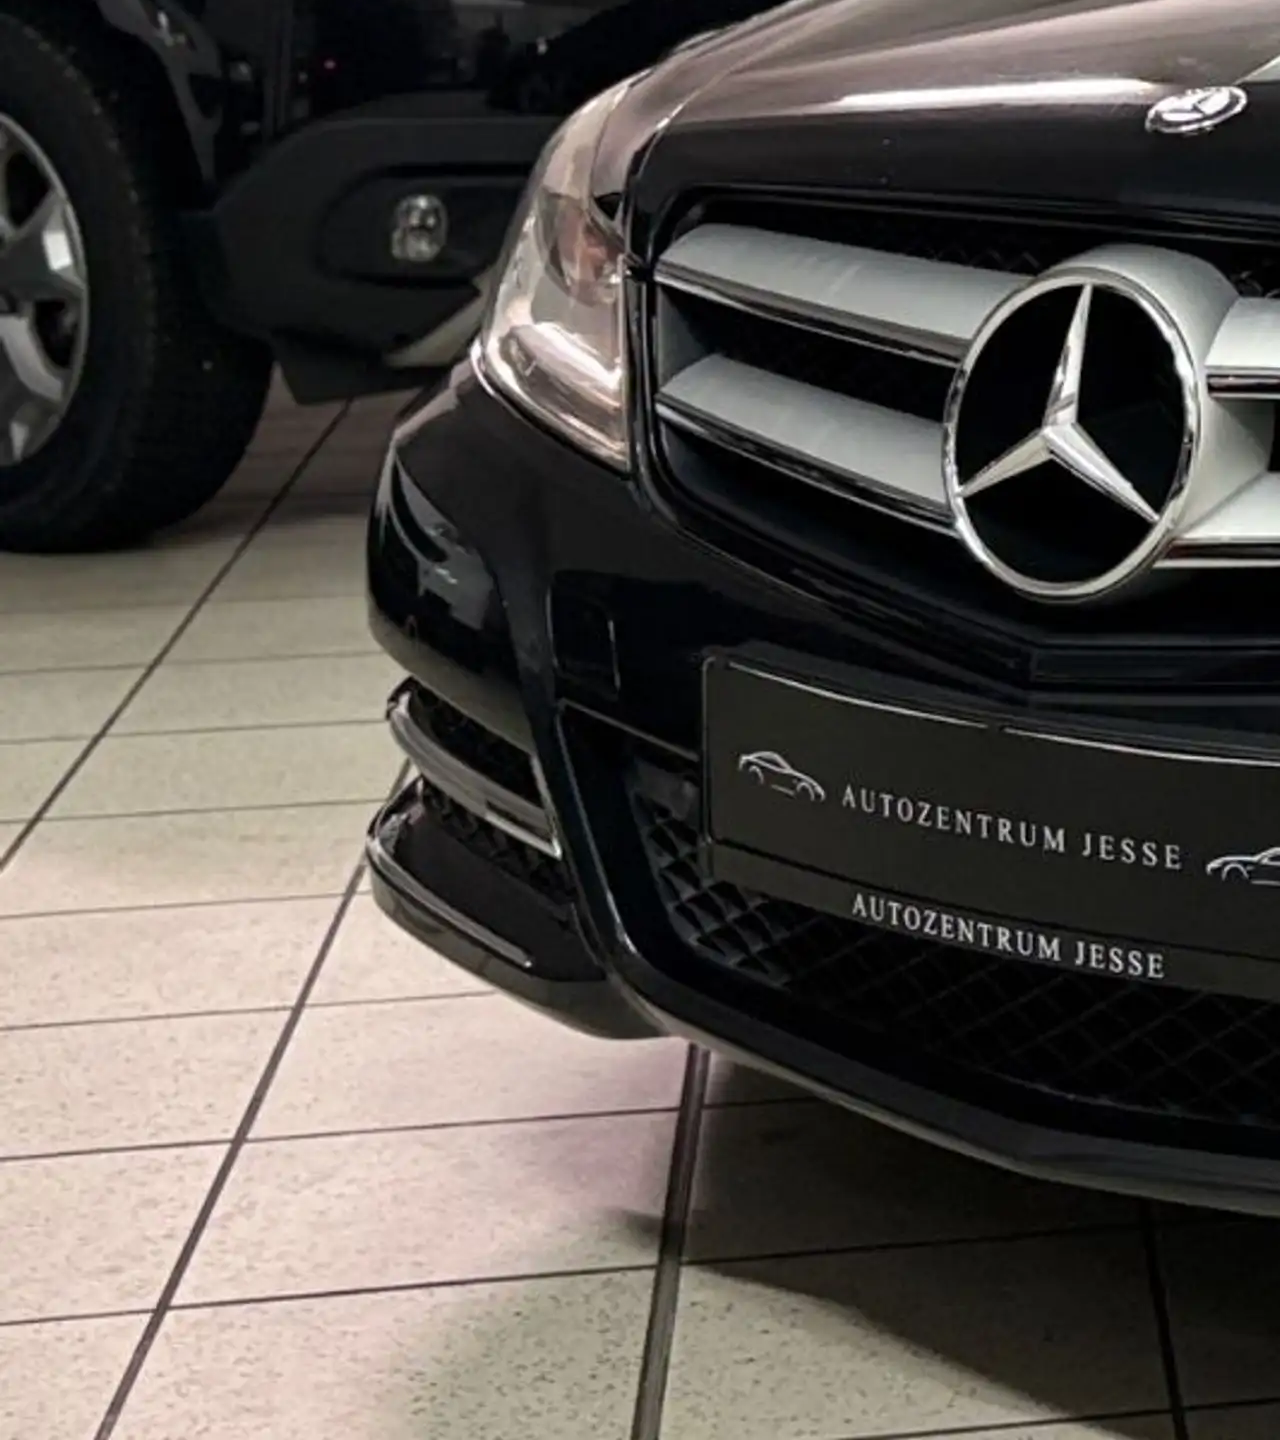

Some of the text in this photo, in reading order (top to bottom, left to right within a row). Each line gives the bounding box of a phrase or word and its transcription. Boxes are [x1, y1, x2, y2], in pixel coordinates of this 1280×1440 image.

[842, 784, 1181, 870] AUTOZENTRUM JESSE
[852, 892, 1164, 979] AUTOZENTRUM JESSE
